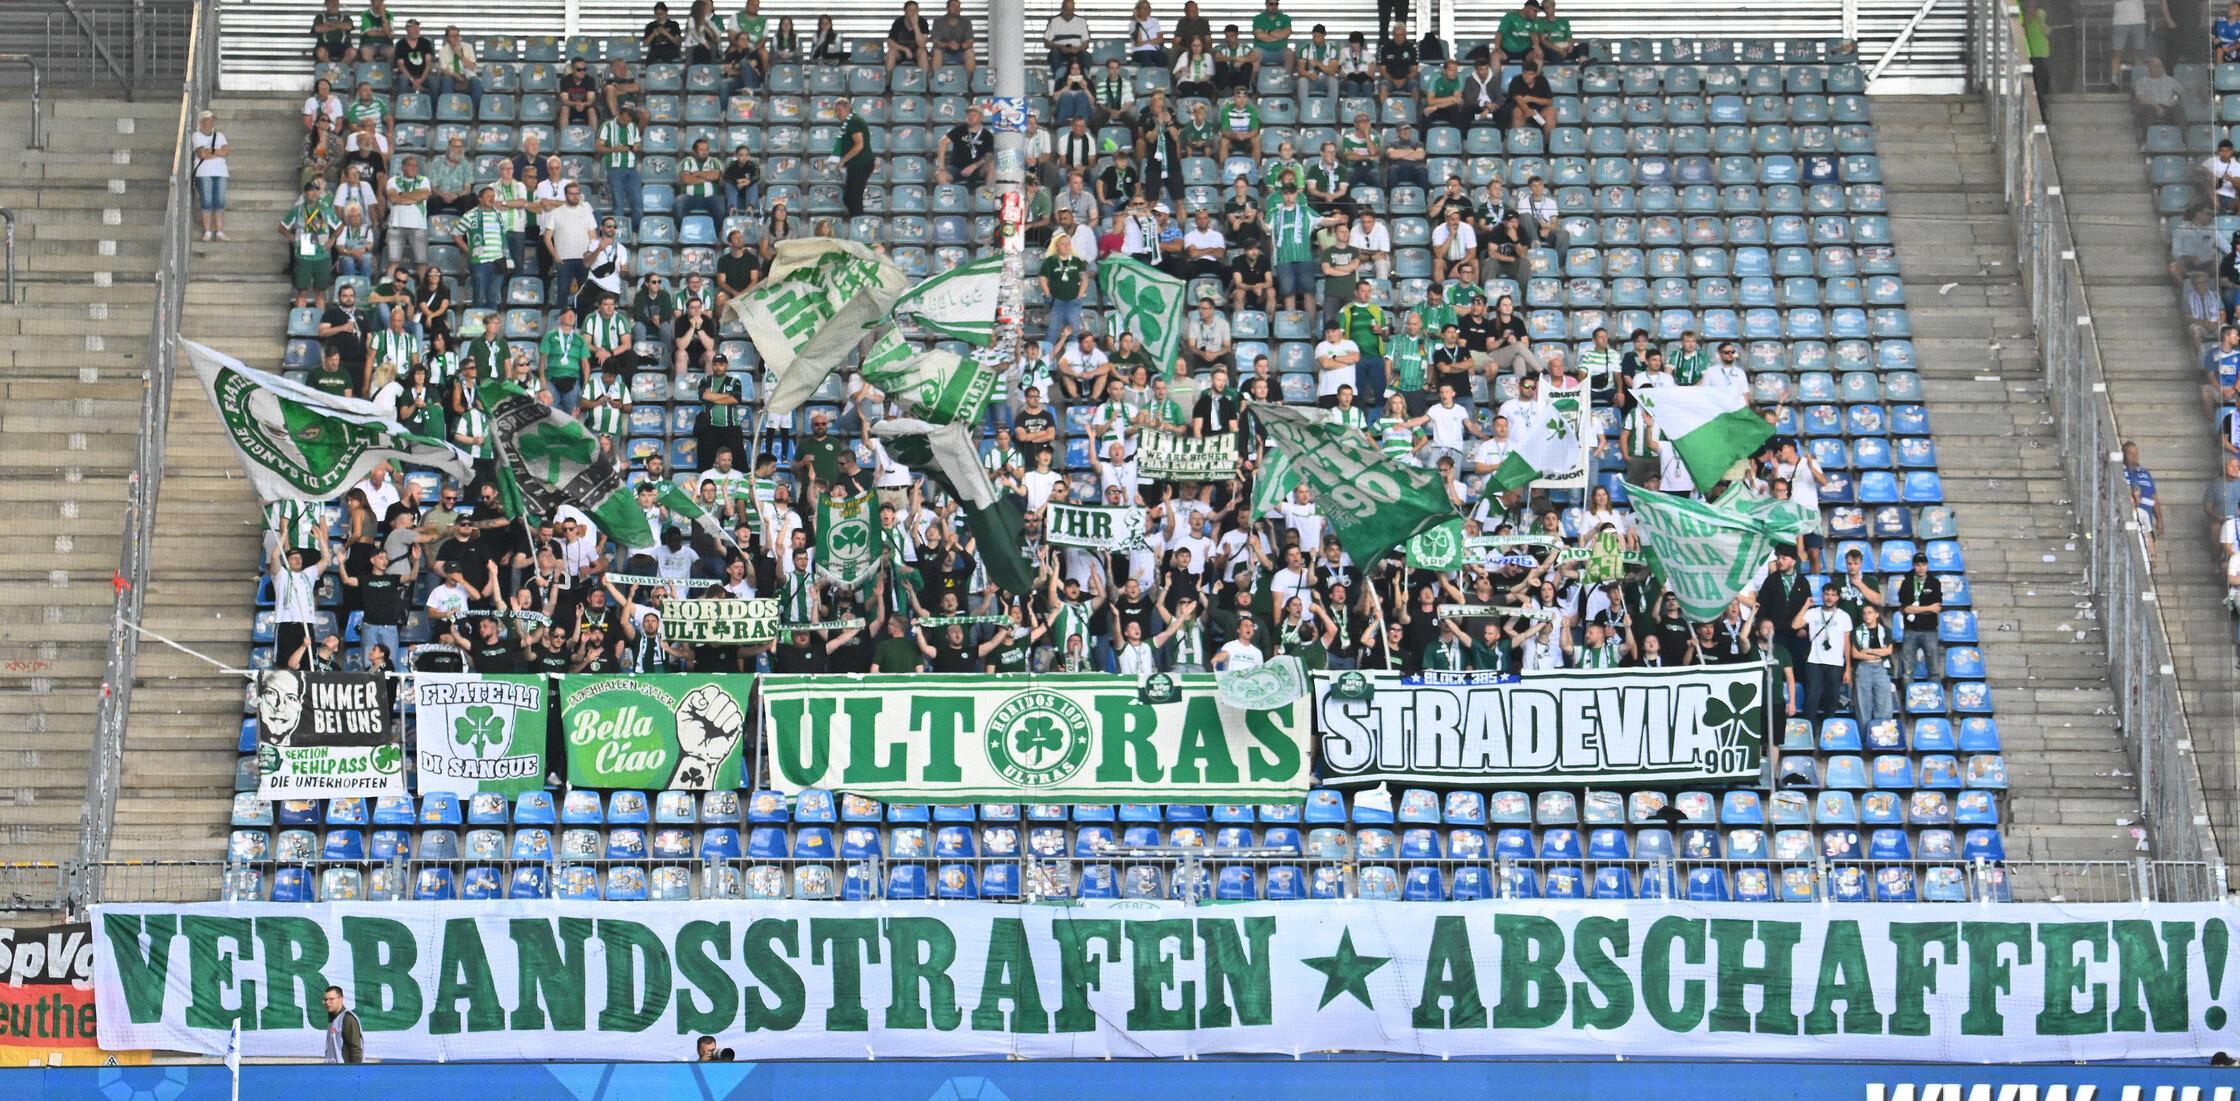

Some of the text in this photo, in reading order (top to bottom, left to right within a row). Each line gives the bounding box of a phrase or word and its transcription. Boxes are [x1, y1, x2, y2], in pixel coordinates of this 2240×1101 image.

[1140, 429, 1235, 453] UNITED
[1140, 459, 1235, 470] THAN EVERY LAW
[1146, 450, 1228, 461] WE ARE HIGHER
[1050, 506, 1114, 540] IHR
[1665, 564, 1724, 601] VITA
[662, 600, 779, 620] HORIDOS
[664, 619, 778, 640] ULT RAS
[1424, 671, 1498, 685] BLOCK 385
[311, 681, 379, 710] IMMER
[420, 682, 540, 711] FRATELLI
[314, 708, 383, 734] BEI UNS
[570, 705, 653, 746] Bella
[991, 694, 1086, 733] HORIDOS 1000
[768, 695, 976, 786] ULT
[1321, 684, 1711, 775] STRADEVIA
[285, 747, 328, 760] SEKTION
[292, 756, 368, 775] FEHLPASS
[421, 751, 539, 779] DI SANGUE
[1705, 746, 1749, 775] 907
[270, 776, 289, 788] DIE
[1003, 761, 1075, 785] ULTRAS
[103, 914, 1277, 1034] VERBANDSSTRAFEN
[1411, 914, 2229, 1037] ABSCHAFFEN!
